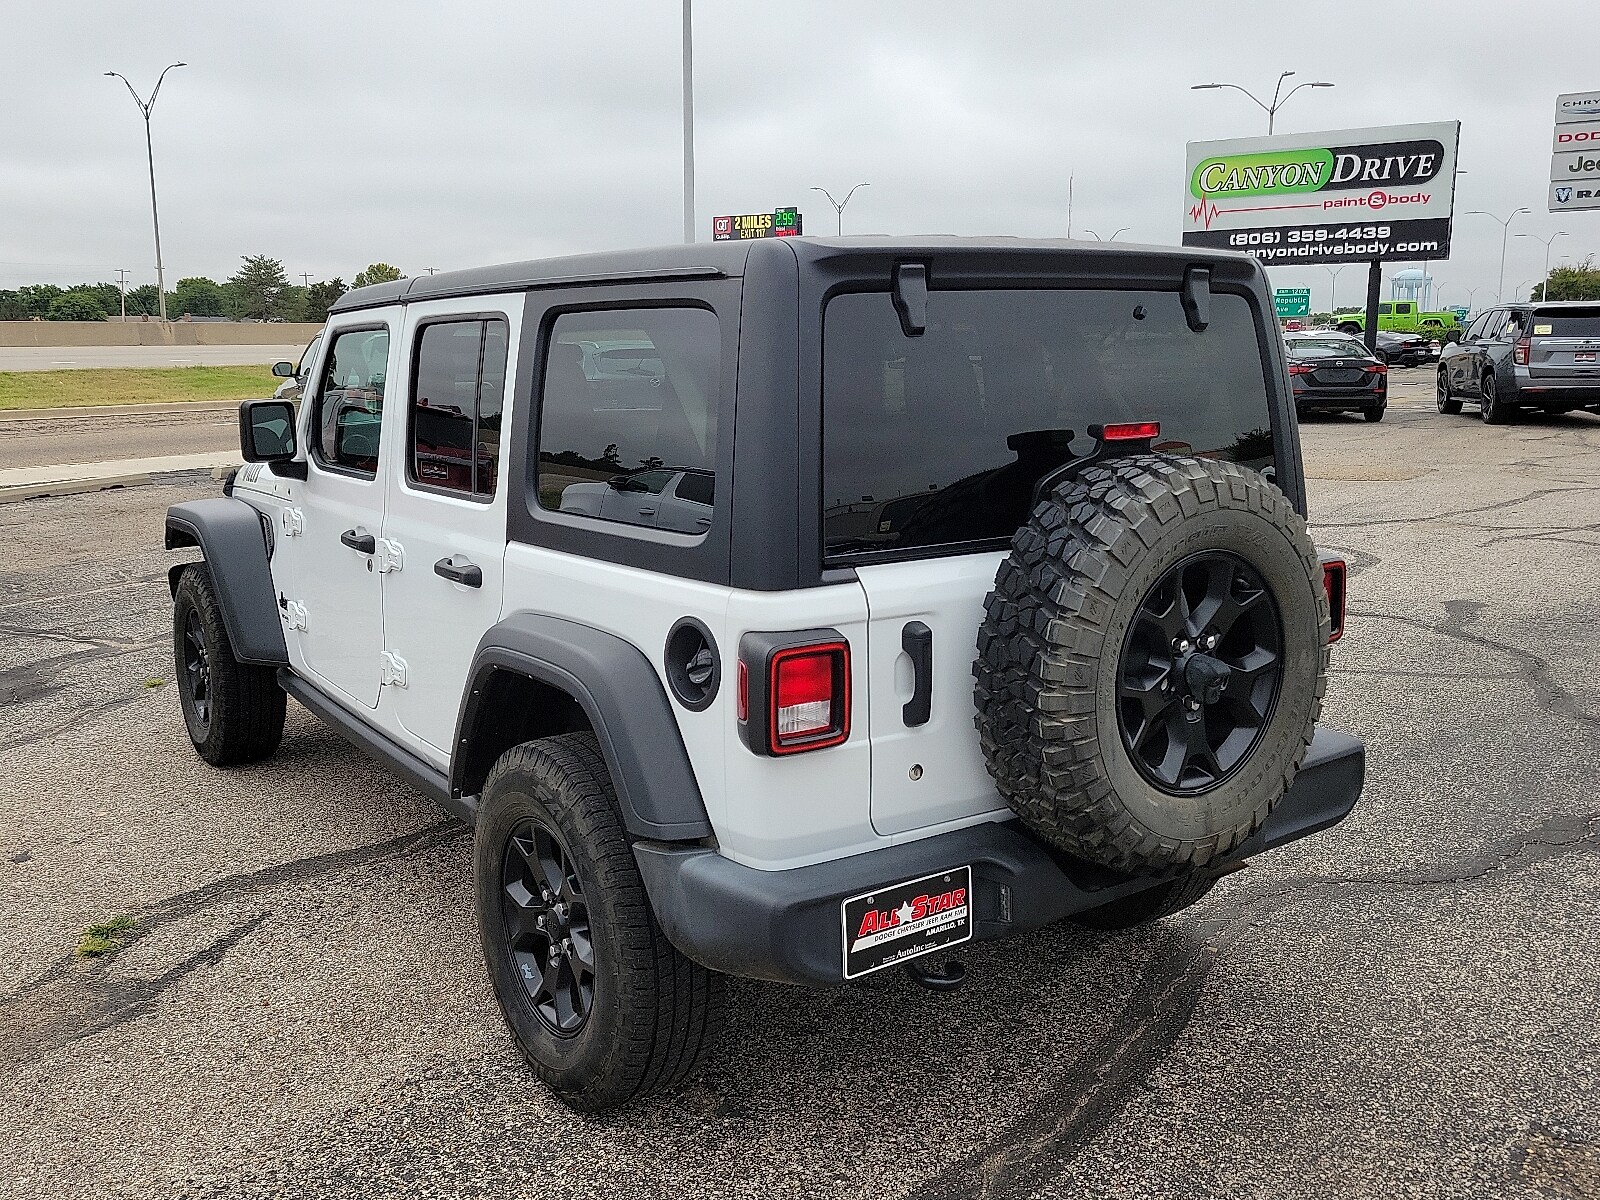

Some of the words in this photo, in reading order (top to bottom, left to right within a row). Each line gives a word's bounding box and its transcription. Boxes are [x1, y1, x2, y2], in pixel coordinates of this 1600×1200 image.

[1199, 161, 1327, 194] CANYON
[1329, 153, 1437, 184] DRIVE
[734, 216, 741, 230] 2
[741, 214, 772, 229] MILES
[740, 228, 754, 239] EXIT
[756, 228, 766, 237] 117
[1229, 231, 1281, 246] (806)
[1287, 226, 1391, 243] 359-4439
[1240, 241, 1438, 259] anyondrivebody.com
[857, 909, 901, 938] ALL
[911, 888, 966, 921] STAR
[874, 931, 896, 942] DODGE
[897, 921, 925, 935] CHRYSLER
[925, 916, 939, 926] JEEP
[940, 912, 953, 921] RAM
